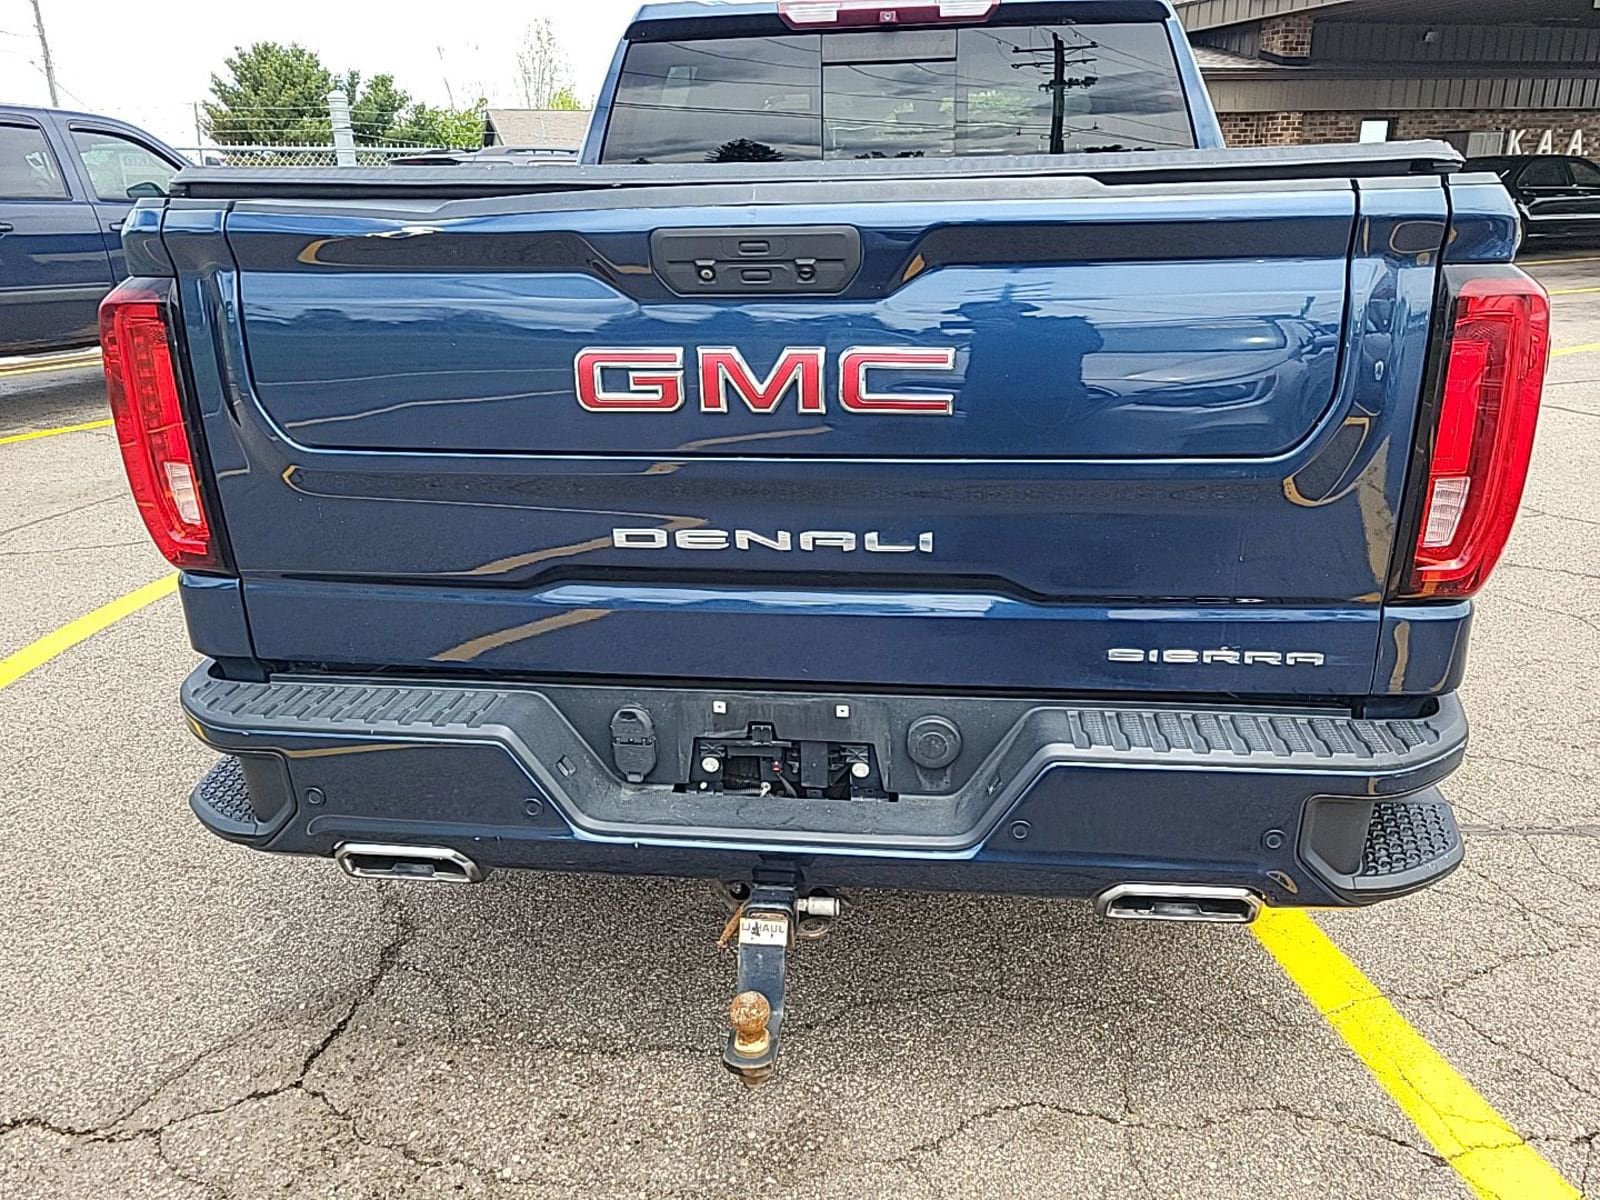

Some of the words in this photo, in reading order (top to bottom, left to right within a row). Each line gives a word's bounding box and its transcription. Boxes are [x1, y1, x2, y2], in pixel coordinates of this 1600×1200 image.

[574, 345, 956, 416] GMC
[612, 528, 934, 553] DENALI
[1107, 648, 1325, 666] SIERRA
